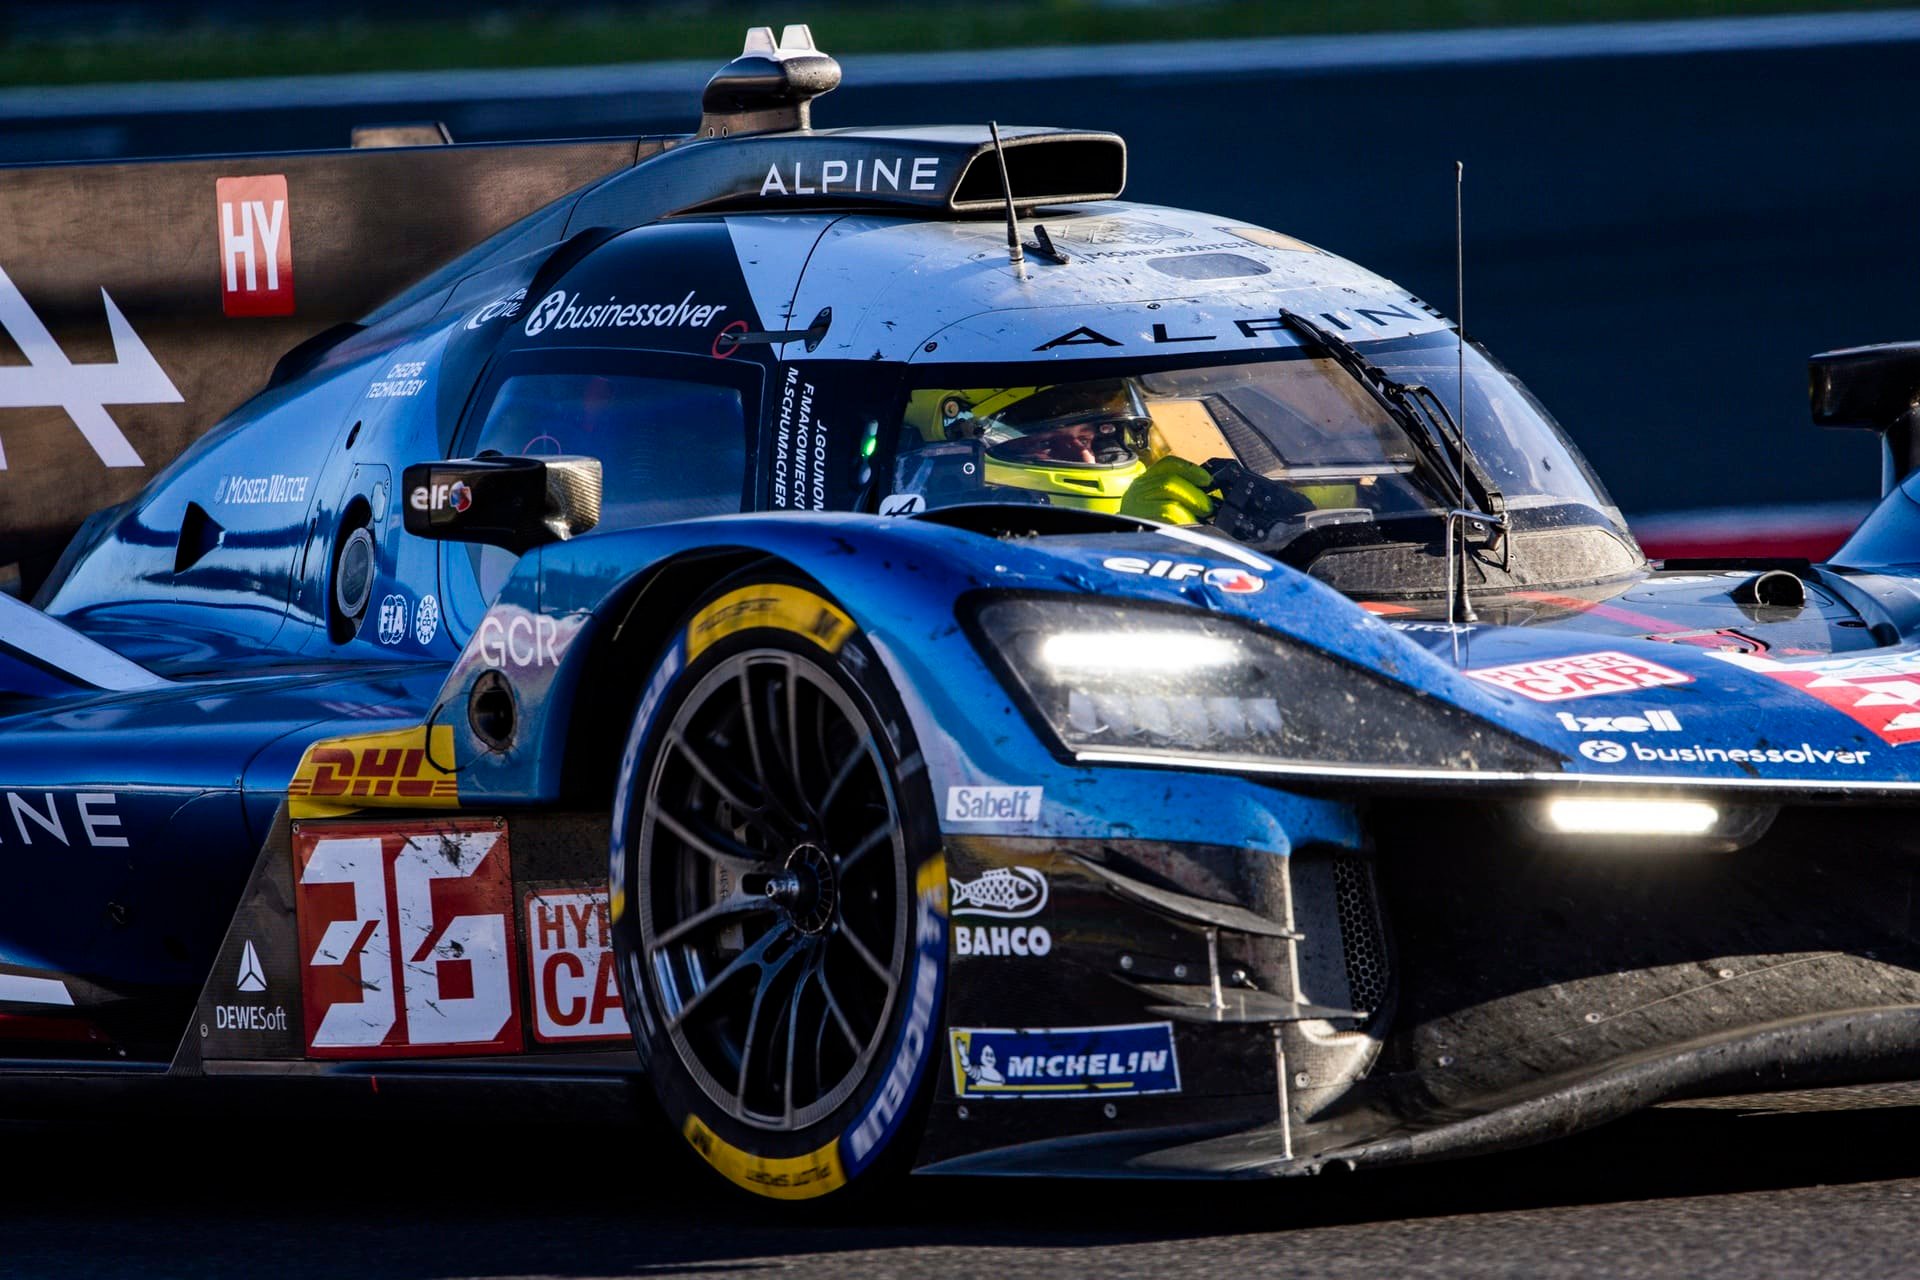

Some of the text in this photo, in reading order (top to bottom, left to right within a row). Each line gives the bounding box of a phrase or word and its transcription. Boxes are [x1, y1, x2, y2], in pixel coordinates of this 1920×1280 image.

[760, 157, 939, 197] ALPINE
[222, 199, 285, 292] HY
[554, 290, 727, 329] businessolver
[365, 380, 428, 399] TECHNOLOGY
[775, 366, 799, 508] M.SCHUMACHER
[794, 382, 815, 510] F.MAKOWIECKI
[410, 484, 450, 510] elf
[1103, 557, 1205, 581] elf
[479, 615, 560, 667] GCR
[1480, 655, 1632, 682] HYPER
[1513, 664, 1668, 695] CAR
[1631, 742, 1871, 765] businessolver
[310, 748, 435, 797] DHL
[0, 791, 131, 848] NE
[956, 789, 1031, 819] Sabelt
[955, 925, 1052, 957] BAHCO
[215, 1005, 288, 1031] DEWESoft
[1007, 1050, 1169, 1078] MICHELIN
